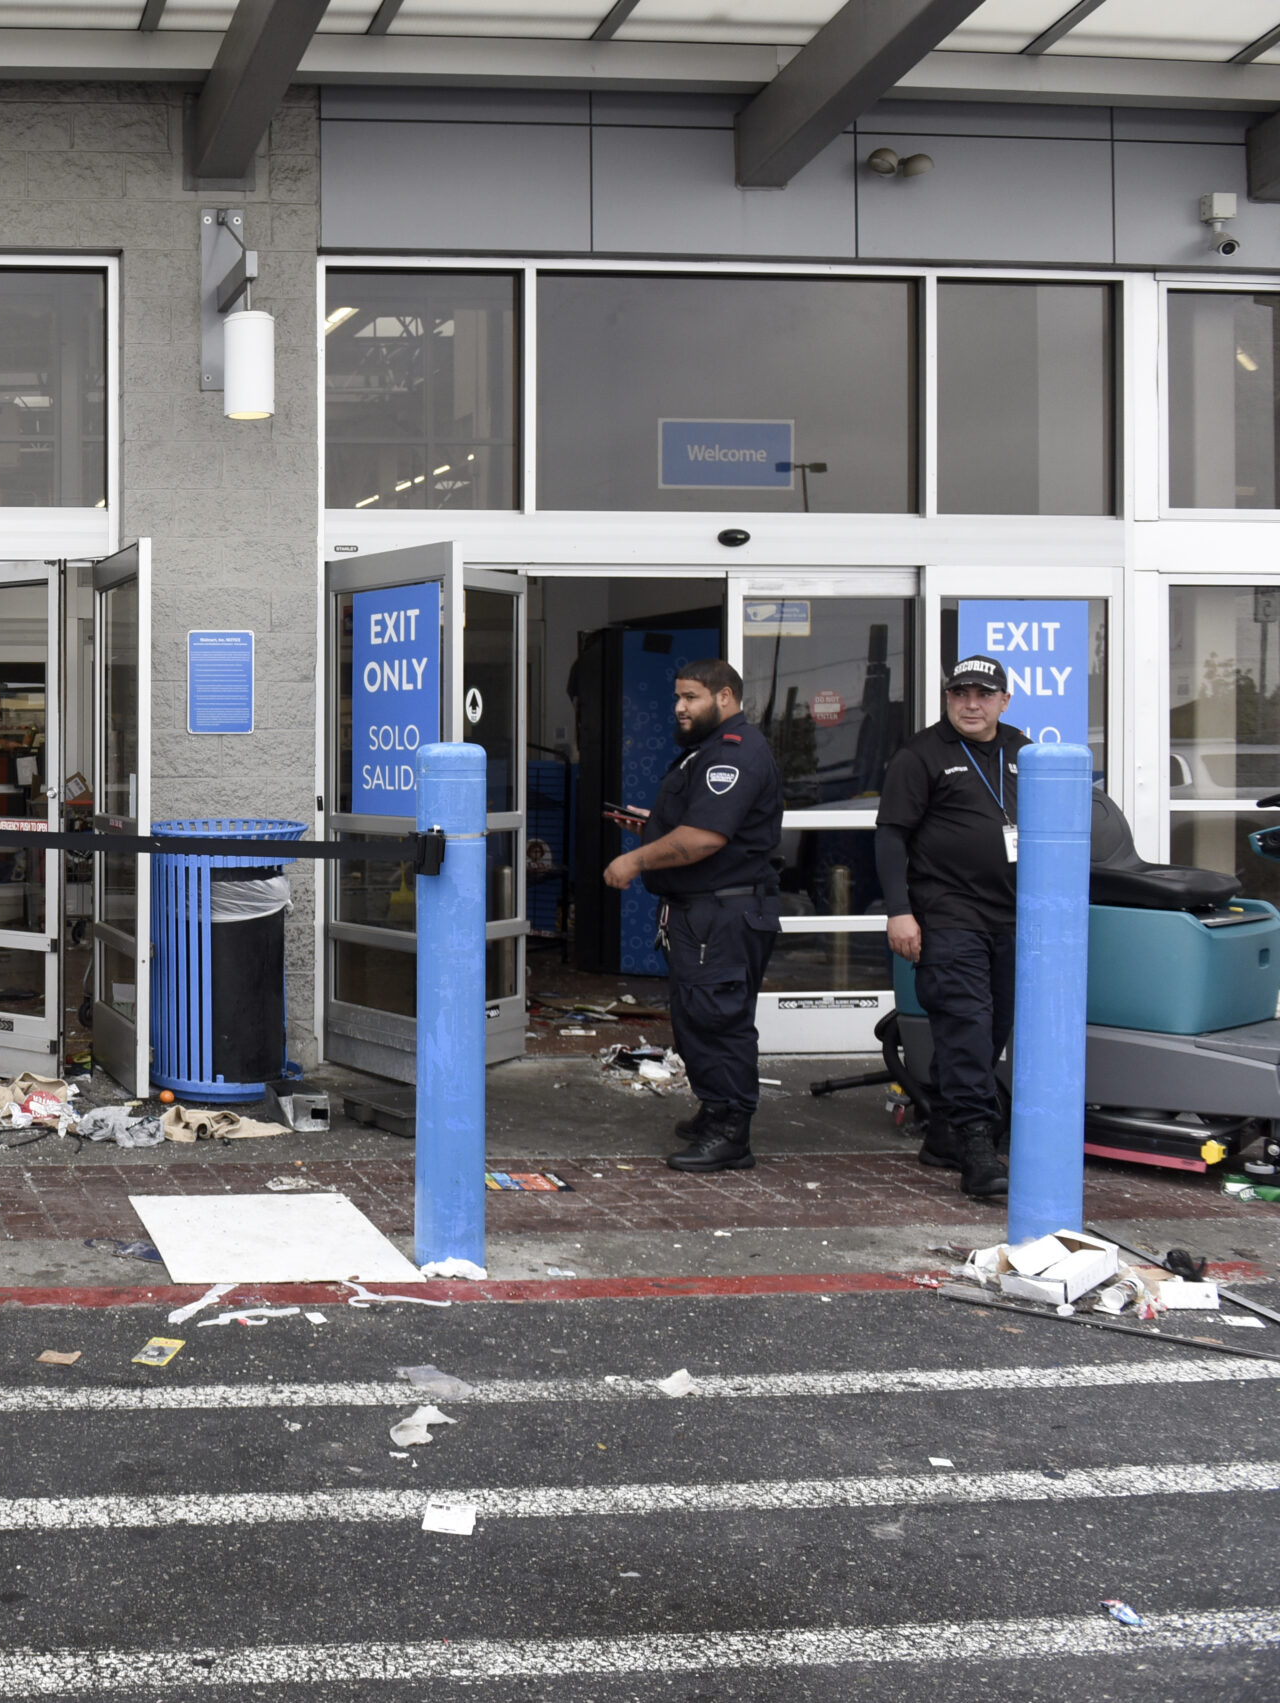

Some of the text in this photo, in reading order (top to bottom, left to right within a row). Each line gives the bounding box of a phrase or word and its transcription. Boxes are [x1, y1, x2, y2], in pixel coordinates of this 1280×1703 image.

[687, 444, 767, 462] Welcome
[370, 608, 420, 645] EXIT
[987, 622, 1060, 651] EXIT
[363, 657, 428, 693] ONLY
[953, 660, 997, 676] SECURITY
[1007, 666, 1073, 696] NLY
[369, 724, 420, 751] SOLO
[362, 764, 417, 791] SALID
[20, 821, 30, 831] PUSH
[31, 822, 36, 832] TO
[37, 822, 48, 832] OPEN
